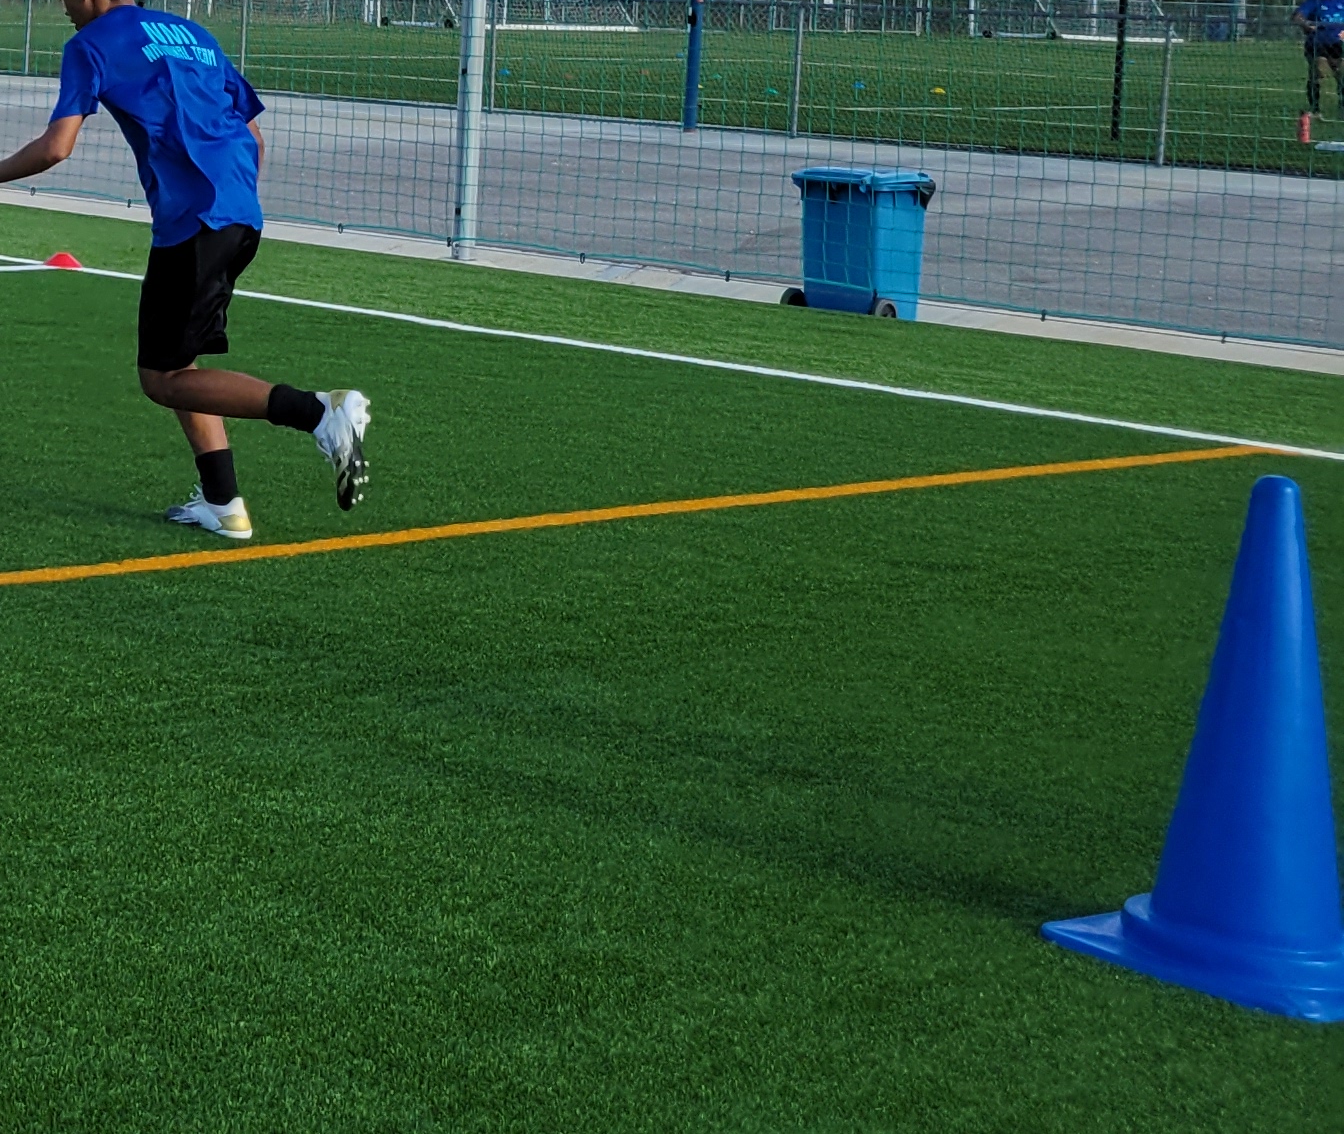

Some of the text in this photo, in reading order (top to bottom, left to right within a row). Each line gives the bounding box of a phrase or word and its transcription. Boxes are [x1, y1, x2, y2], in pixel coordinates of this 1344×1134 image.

[140, 21, 197, 45] NMI
[141, 43, 218, 67] NATNAL TEAM
